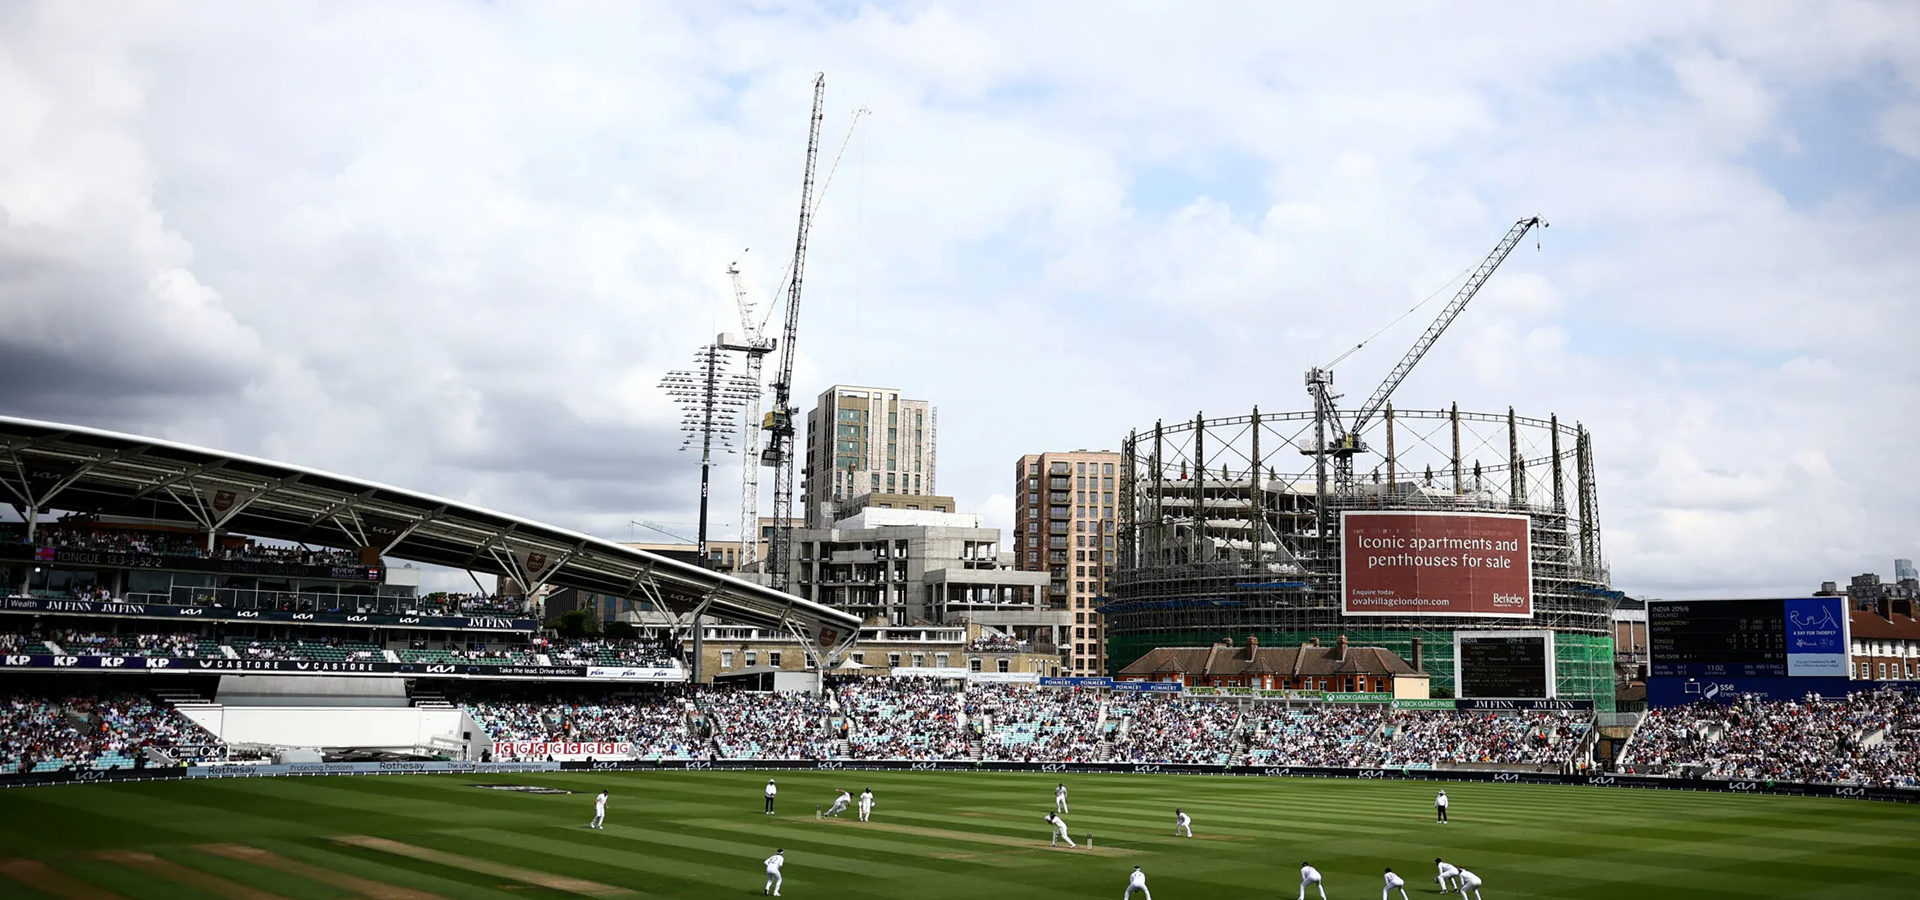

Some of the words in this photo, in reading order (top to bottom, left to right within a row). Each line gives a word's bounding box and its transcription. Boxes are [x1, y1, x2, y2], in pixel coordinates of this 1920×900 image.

[1358, 534, 1405, 549] Iconic
[1409, 537, 1492, 551] apartments
[1495, 538, 1518, 552] and
[57, 551, 101, 564] TONGUE
[1368, 552, 1458, 569] penthouses
[1462, 554, 1482, 568] for
[1486, 556, 1511, 569] sale
[1353, 589, 1376, 597] Enquire
[1377, 589, 1395, 597] today
[10, 600, 37, 608] Wealth
[1352, 597, 1450, 607] ovalvillagelondon.com
[1493, 593, 1525, 608] Berkeley
[46, 601, 62, 611] JM
[65, 601, 92, 611] FINN
[101, 603, 116, 612] JM
[118, 604, 145, 614] FINN
[467, 618, 484, 627] JM
[486, 619, 513, 628] FINN
[5, 655, 31, 667] KP
[53, 656, 79, 667] KP
[100, 657, 125, 668] KP
[146, 658, 170, 669] KP
[217, 660, 279, 670] CASTORE
[313, 663, 374, 671] CASTORE
[539, 668, 556, 676] Drive
[1474, 701, 1489, 709] JM
[1490, 700, 1514, 709] FINN
[1532, 701, 1549, 709] JM
[1549, 701, 1574, 709] FINN
[208, 766, 257, 776] Rothesay
[290, 764, 324, 774] Protecting
[325, 763, 354, 772] Pensions
[379, 762, 425, 772] Rothesay
